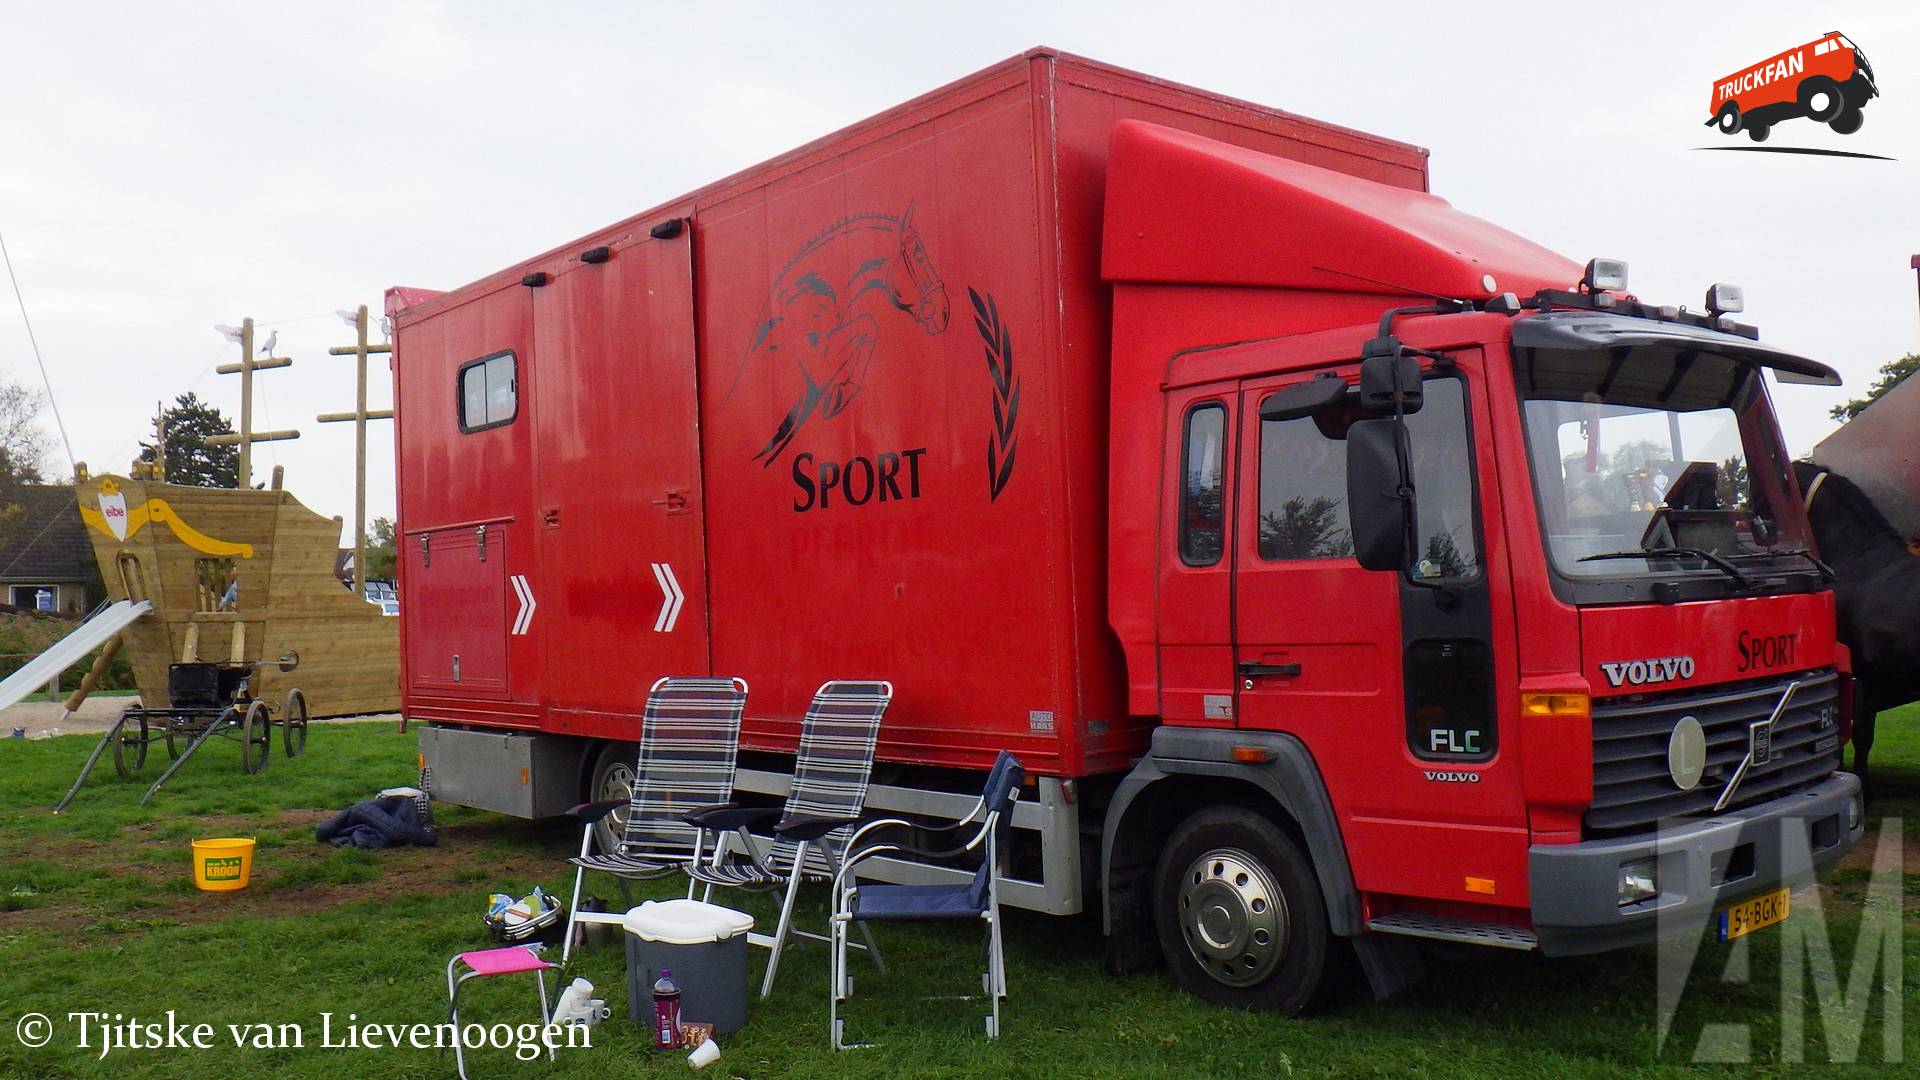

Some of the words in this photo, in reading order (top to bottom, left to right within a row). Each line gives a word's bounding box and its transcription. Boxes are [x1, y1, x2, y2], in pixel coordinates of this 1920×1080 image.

[792, 447, 927, 513] SPORT
[105, 506, 124, 517] eibe
[1737, 630, 1797, 673] SPORT
[1602, 656, 1695, 687] VOLVO
[1430, 729, 1481, 752] FLC
[1424, 771, 1480, 783] VOLVO
